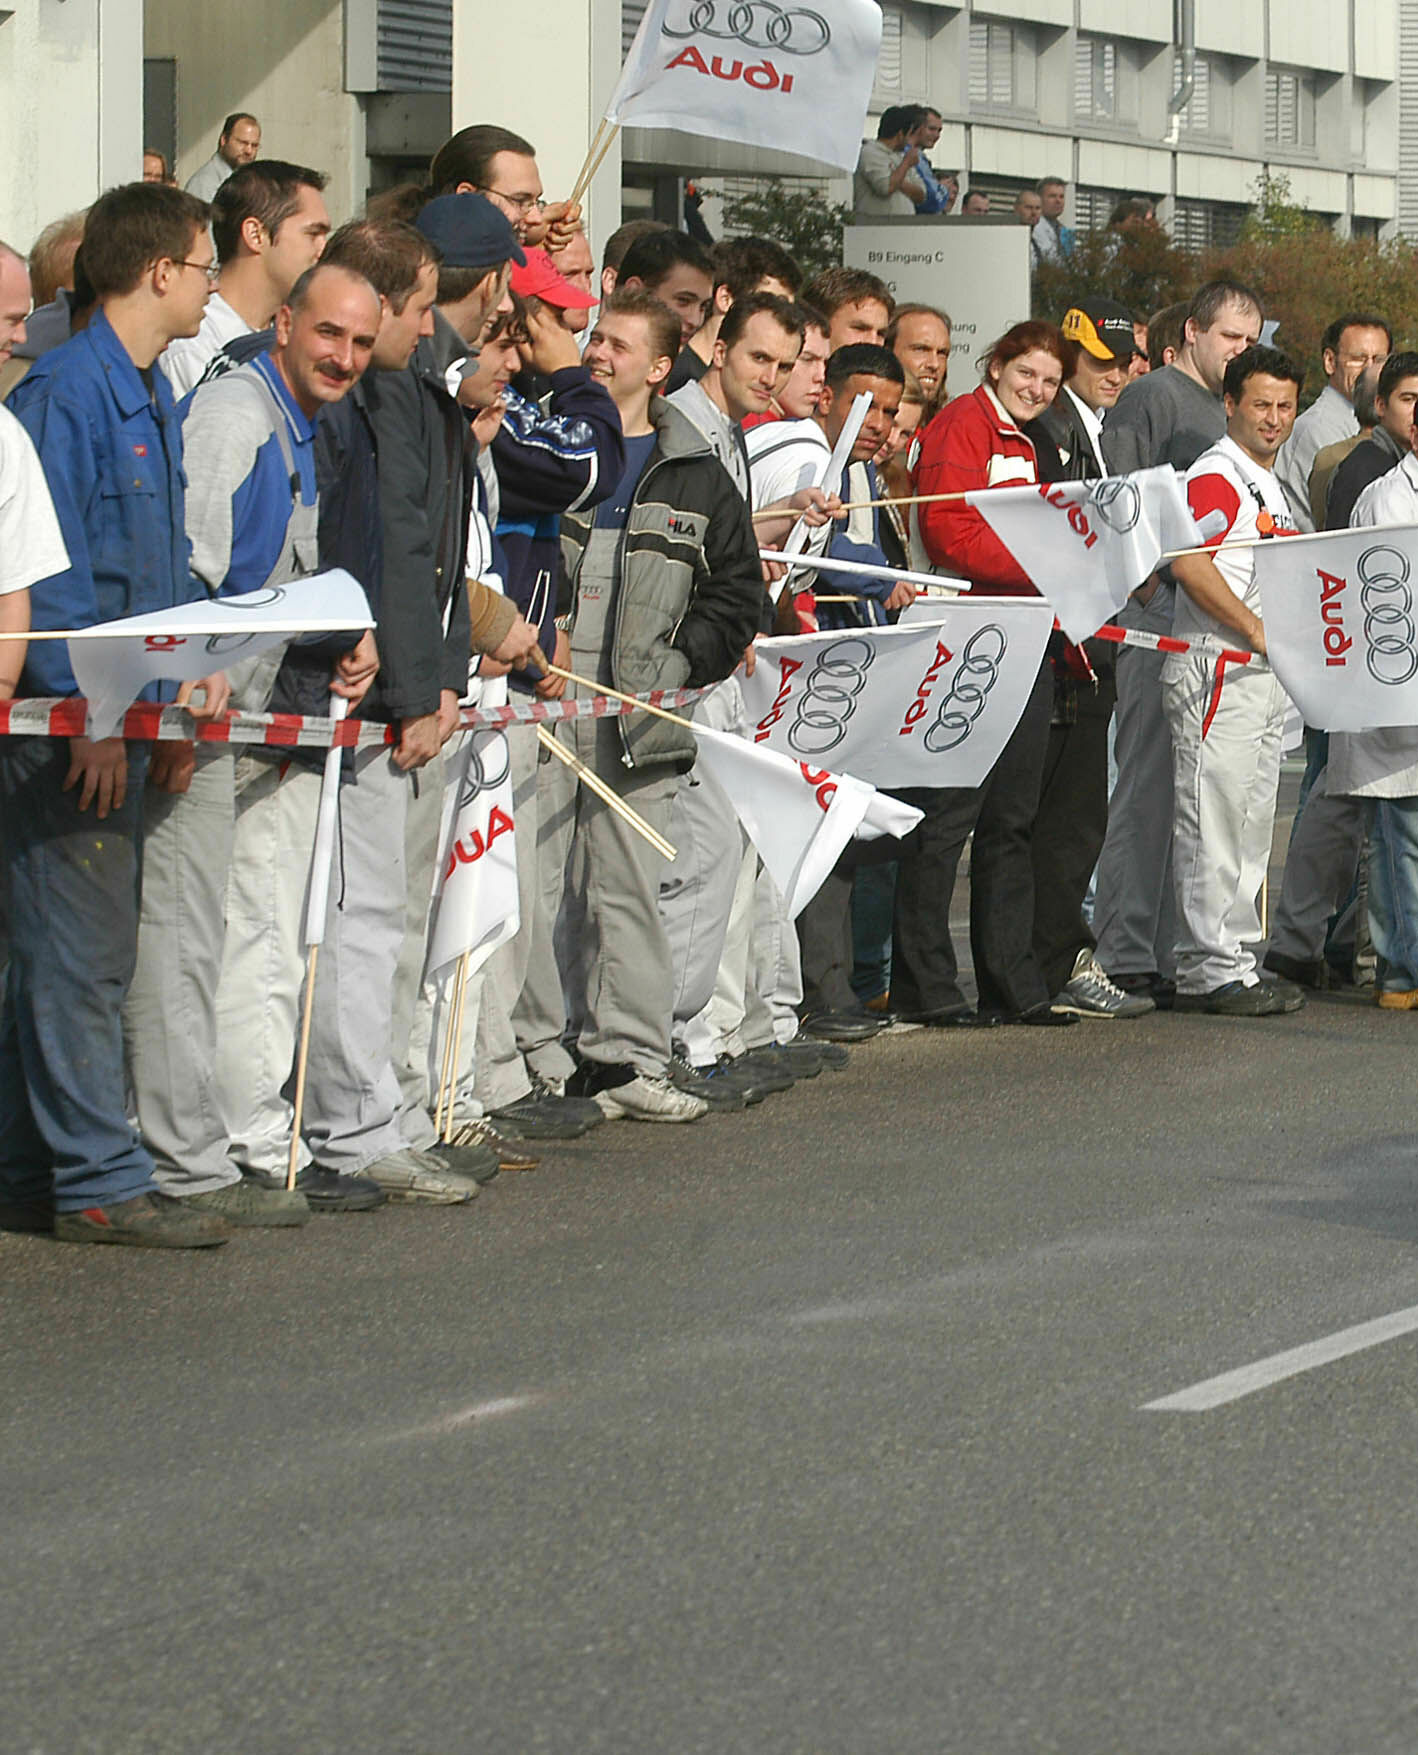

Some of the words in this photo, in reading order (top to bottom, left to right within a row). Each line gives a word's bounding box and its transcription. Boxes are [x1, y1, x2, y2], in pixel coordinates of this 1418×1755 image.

[664, 46, 794, 93] Audi
[868, 251, 883, 263] B9
[886, 251, 932, 264] Eingang
[935, 251, 944, 263] C
[1316, 568, 1352, 667] Audi
[754, 656, 804, 743] Audi
[899, 640, 954, 736] Audi
